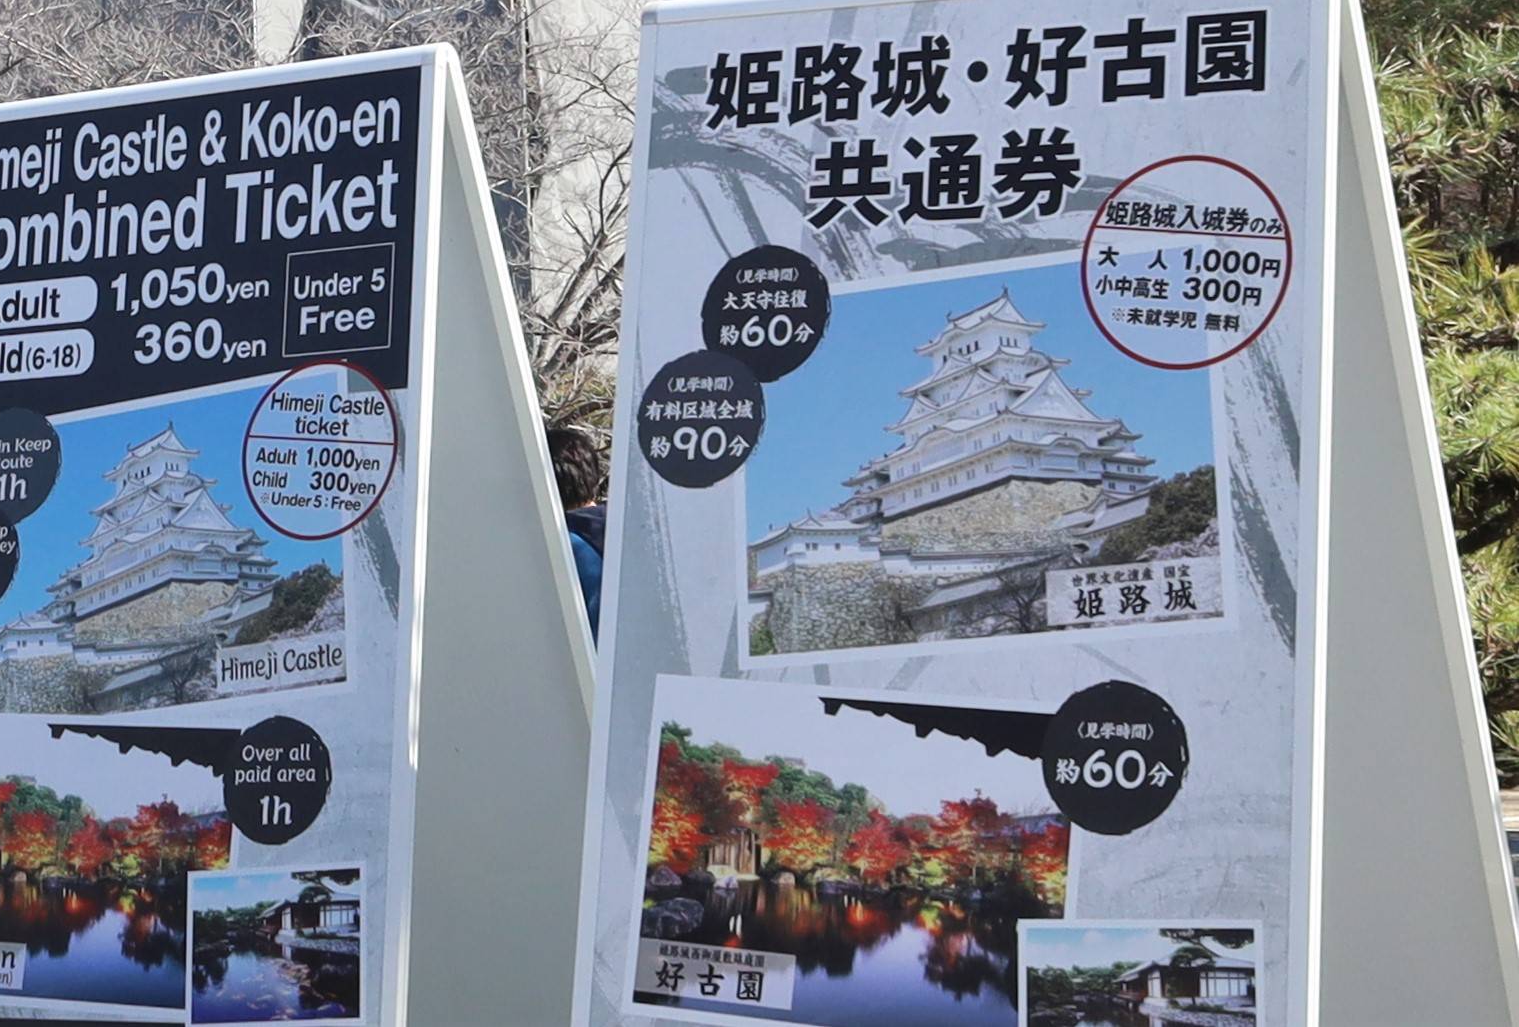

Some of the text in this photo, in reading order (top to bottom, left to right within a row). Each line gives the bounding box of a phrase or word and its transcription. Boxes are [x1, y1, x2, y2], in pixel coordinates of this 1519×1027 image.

[705, 9, 1267, 130] 姫路城・好古園
[74, 114, 187, 181] Castle
[200, 110, 226, 166] &
[241, 96, 401, 162] Koko-en
[805, 126, 1082, 230] 共通券
[226, 158, 399, 243] Ticket
[1105, 201, 1284, 235] 姫路城入城券のみ
[1182, 248, 1281, 279] 1,000円
[294, 268, 386, 301] Under 5
[722, 289, 808, 310] 大天守往復
[1095, 275, 1262, 307] 小中高生 300円
[299, 305, 376, 335] Free
[719, 314, 815, 348] 約60分
[1204, 313, 1240, 332] 無料
[270, 392, 385, 416] Himeji Castle
[644, 400, 755, 421] 有料区域全域
[296, 416, 349, 437] ticket
[15, 438, 52, 453] Keep
[255, 447, 298, 465] Adult
[649, 425, 750, 461] 約90分
[252, 471, 288, 488] Child
[331, 496, 361, 511] Free
[1073, 580, 1197, 619] 姫路城
[221, 643, 343, 682] Himeji Castle
[242, 742, 311, 763] Over all
[234, 765, 316, 786] paid area
[1054, 748, 1174, 789] 約60分
[260, 795, 292, 826] 1h
[655, 960, 764, 1003] 好古園
